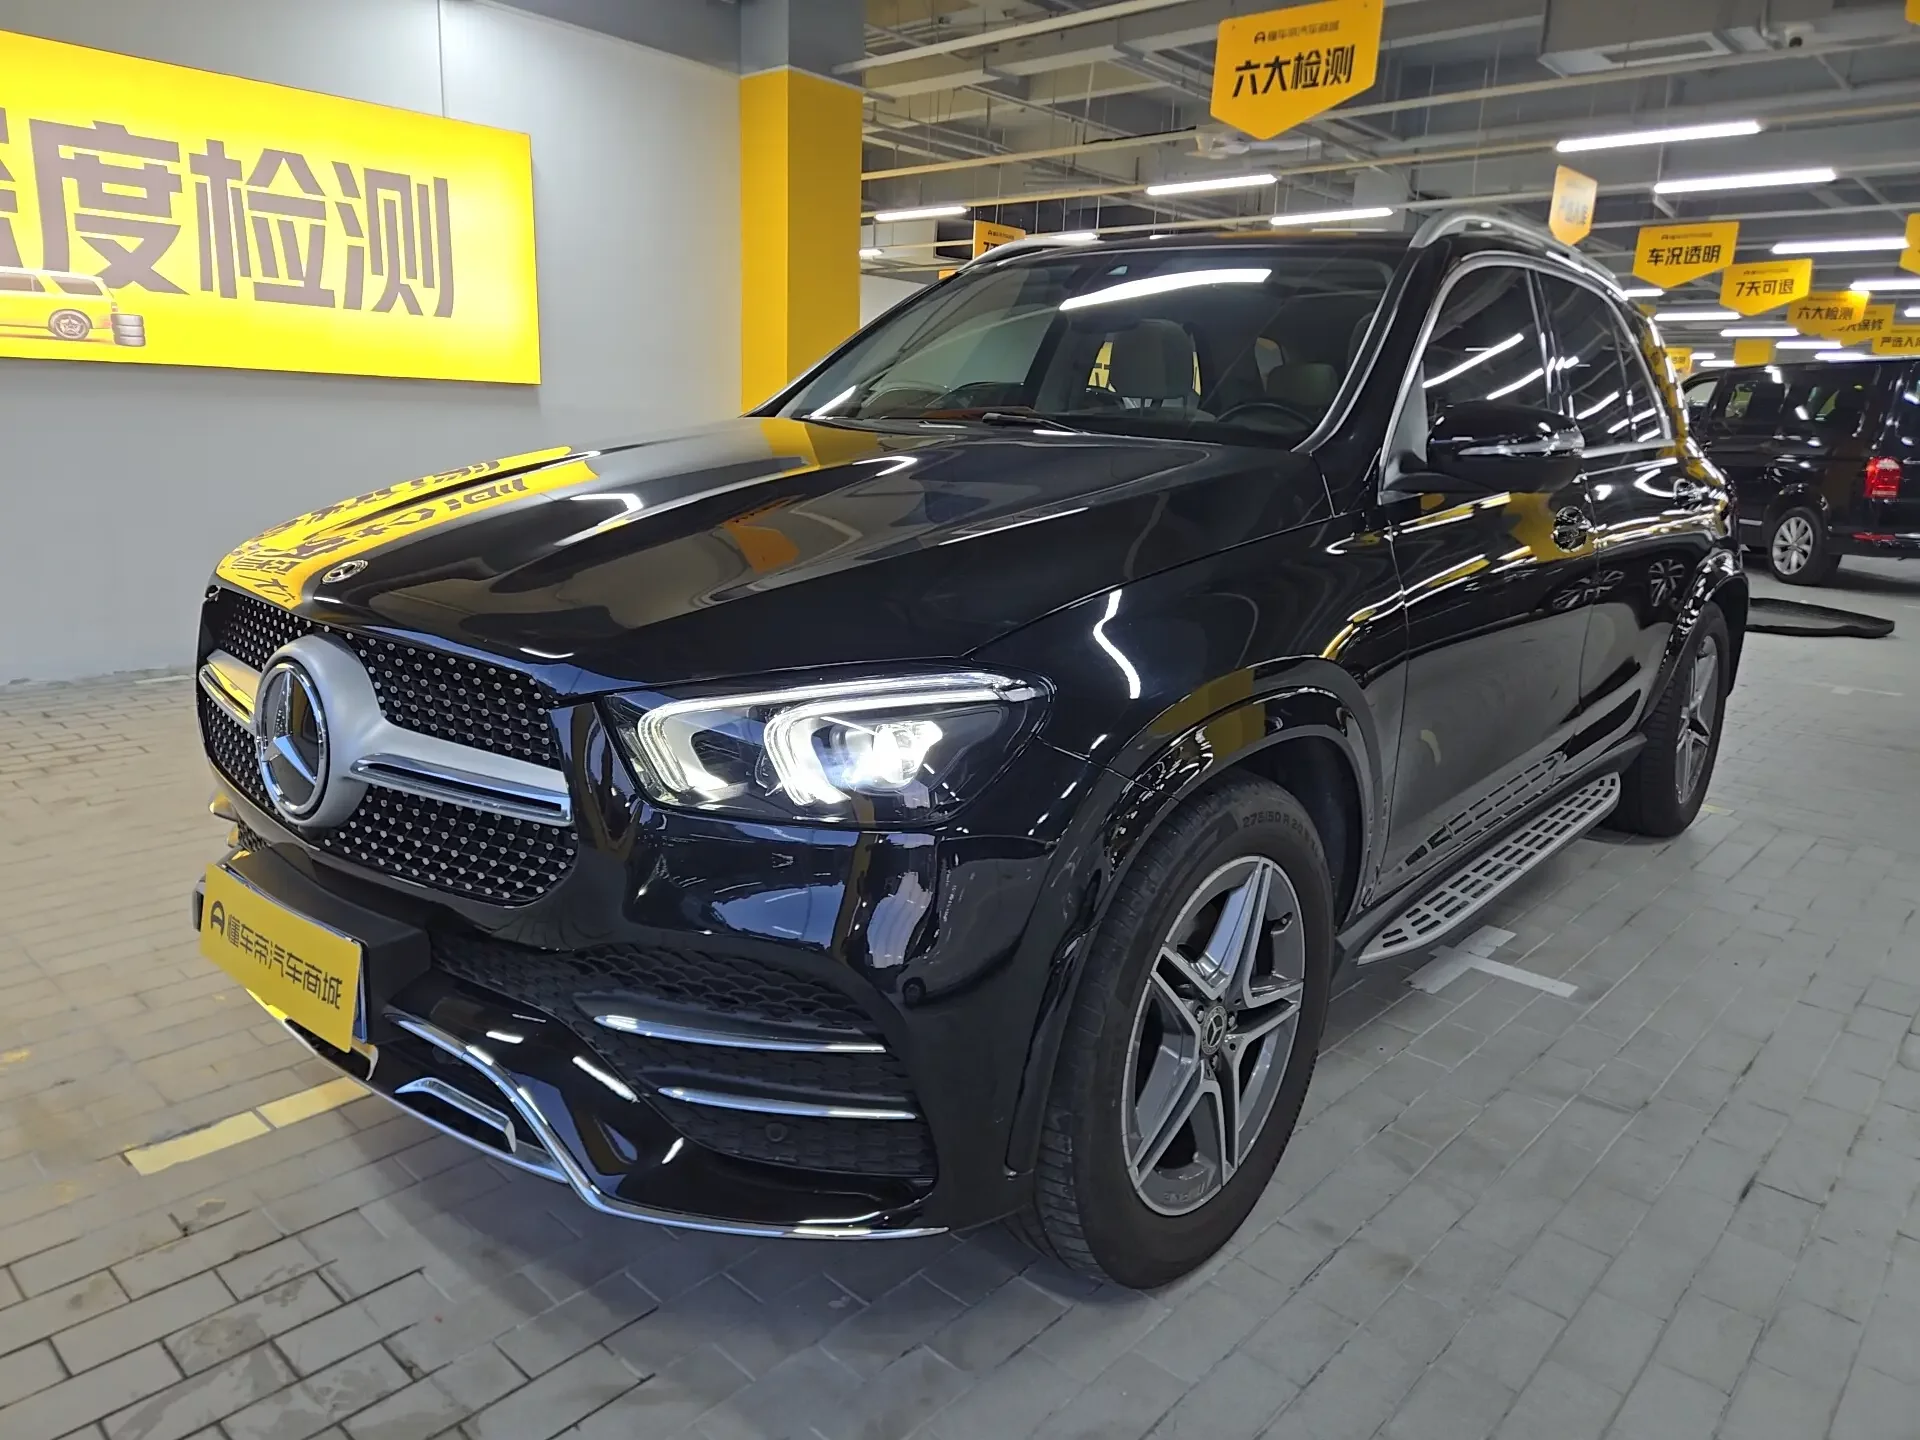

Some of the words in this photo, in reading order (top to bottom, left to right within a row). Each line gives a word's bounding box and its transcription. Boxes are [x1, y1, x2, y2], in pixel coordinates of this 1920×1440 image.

[1232, 44, 1355, 99] 六大检测
[1646, 244, 1722, 266] 车况透明
[1735, 278, 1795, 297] 7天可退
[226, 913, 343, 1010] 懂车帝汽车商城
